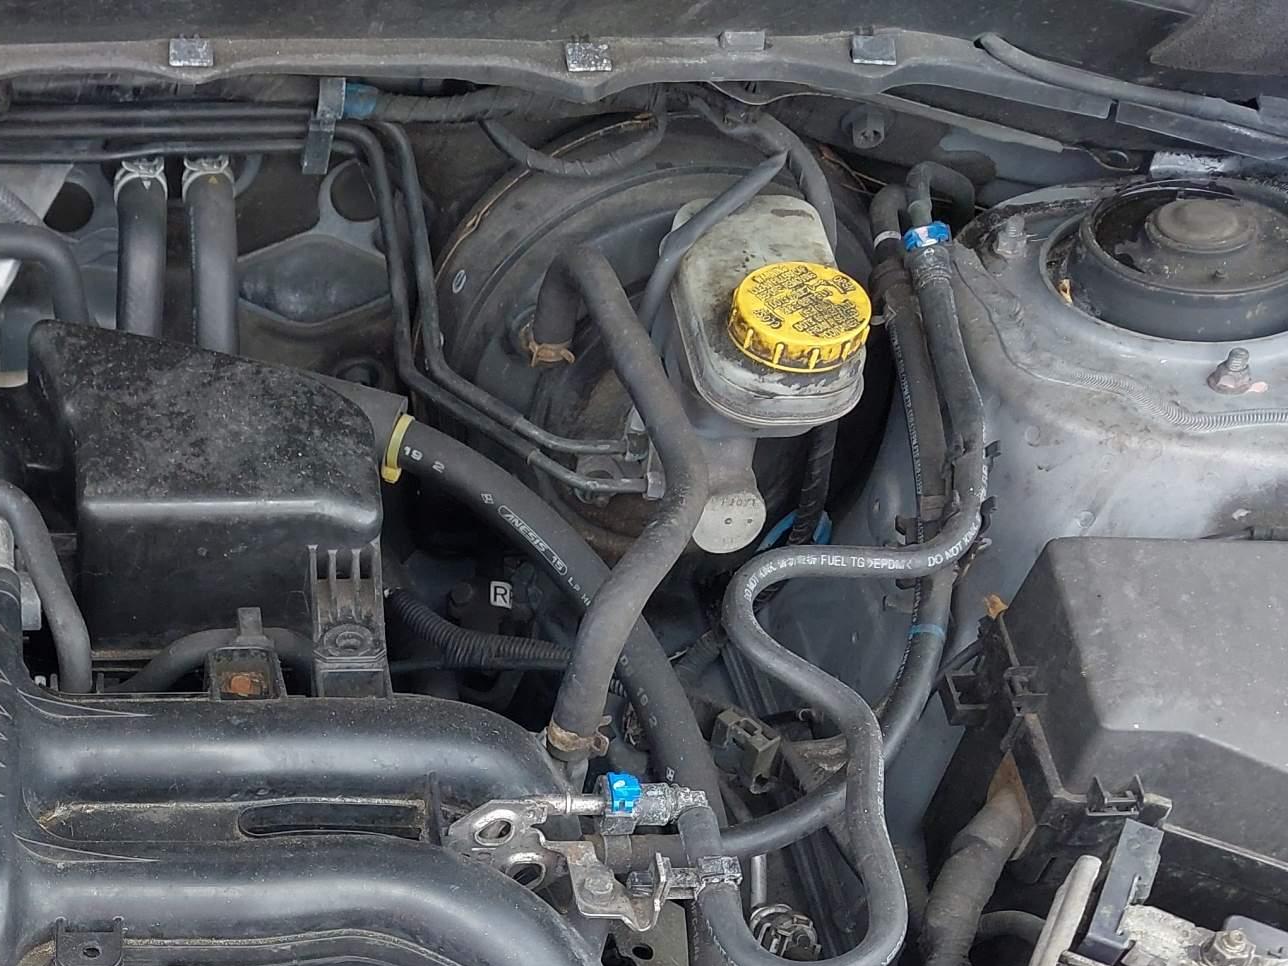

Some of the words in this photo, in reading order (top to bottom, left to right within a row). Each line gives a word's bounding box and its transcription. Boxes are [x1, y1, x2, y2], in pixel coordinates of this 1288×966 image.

[403, 446, 424, 462] 19
[432, 461, 445, 473] 2
[820, 554, 848, 568] FUEL
[850, 556, 866, 569] TG
[928, 552, 944, 567] DO
[944, 542, 965, 560] NOT
[493, 586, 508, 603] R
